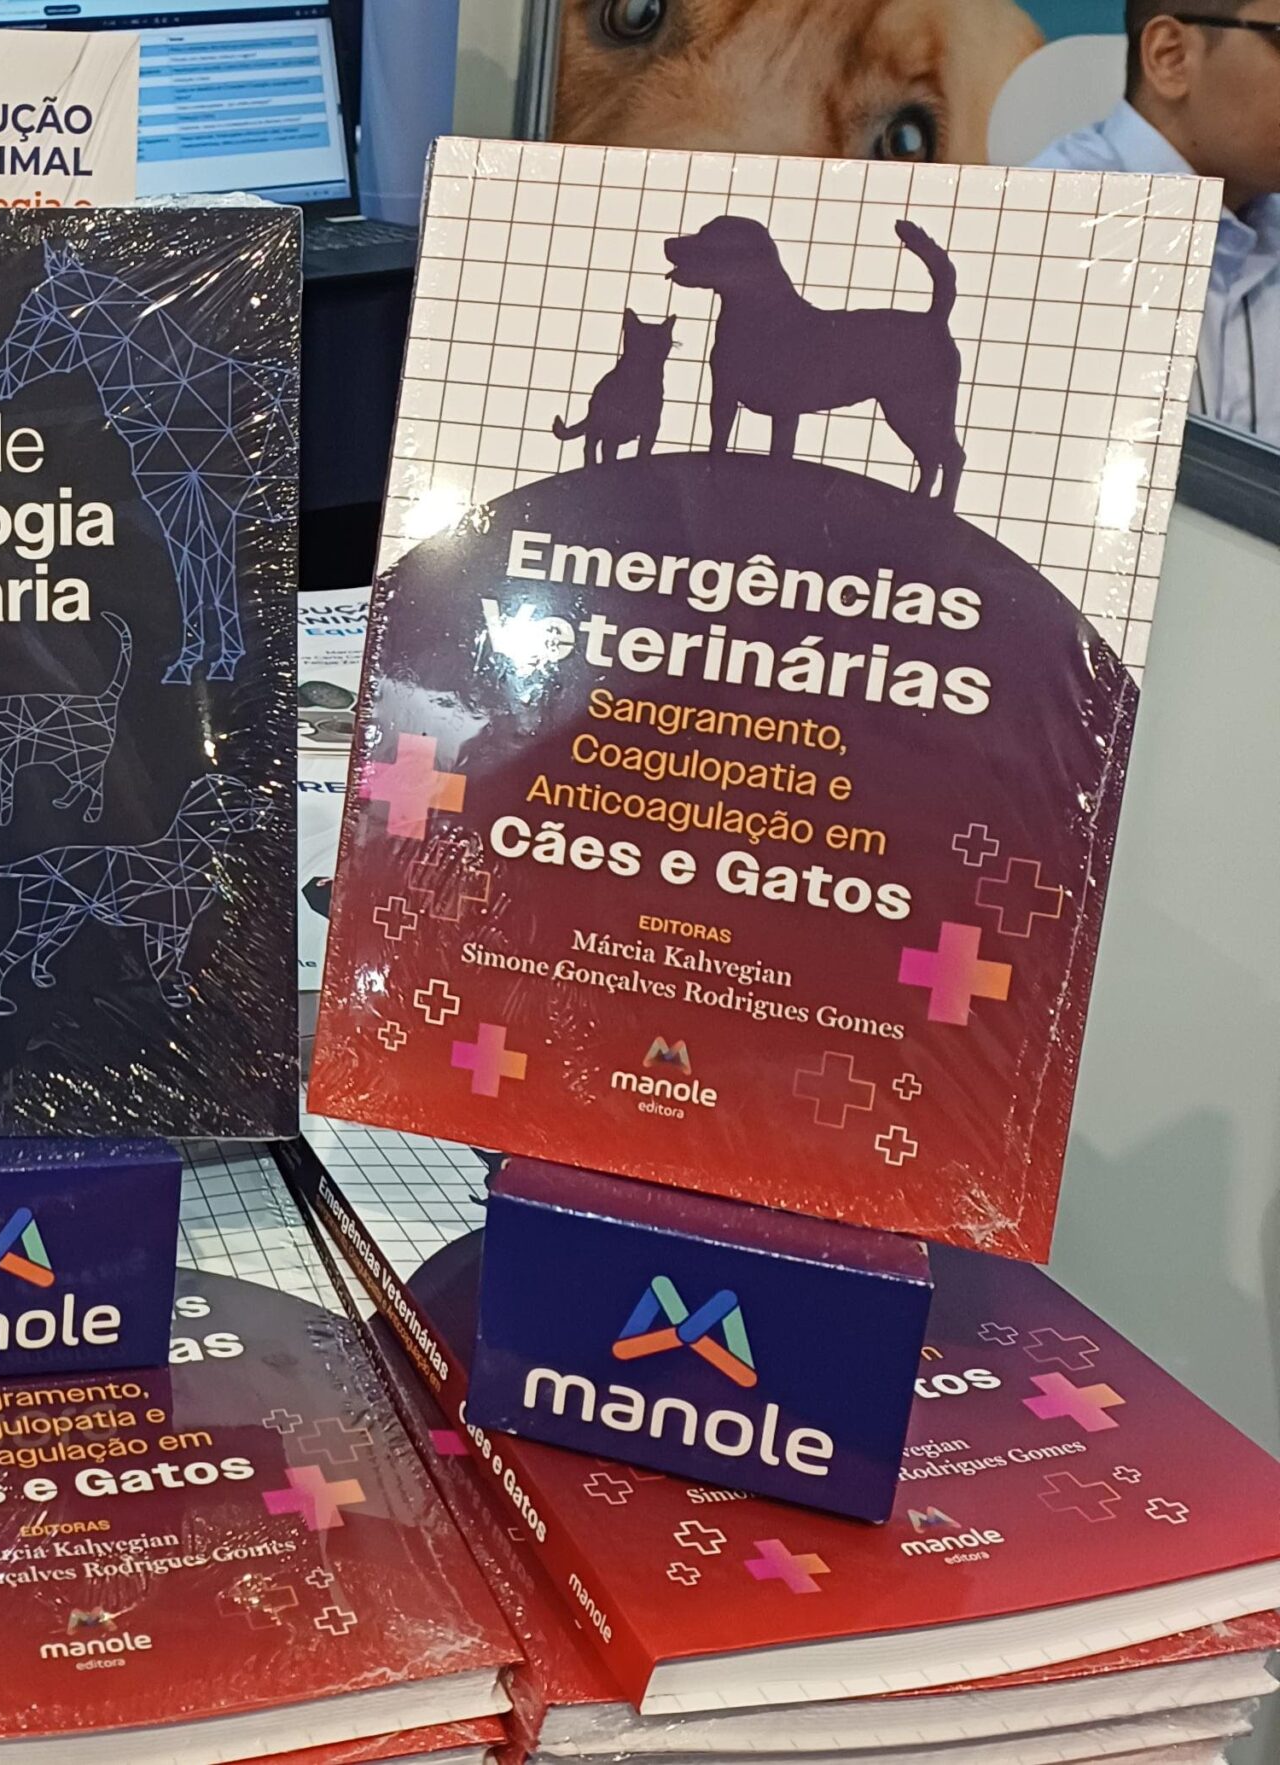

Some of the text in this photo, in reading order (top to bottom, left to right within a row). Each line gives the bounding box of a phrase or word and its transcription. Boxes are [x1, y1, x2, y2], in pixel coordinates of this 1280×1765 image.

[505, 529, 983, 631] Emergências
[588, 687, 849, 755] Sangramento,
[571, 733, 852, 800] Coagulopatia e
[525, 773, 887, 856] Anticoagulação em
[490, 815, 913, 921] Cães e Gatos
[638, 914, 733, 944] EDITORAS
[571, 929, 793, 988] Márcia Kahvegian
[460, 942, 906, 1040] Simone Gonçalves Rodrigues Gomes
[610, 1069, 718, 1108] manole
[638, 1099, 685, 1120] editora
[319, 1175, 381, 1279] Emergências
[381, 1267, 449, 1381] Veterinárias
[146, 1407, 166, 1424] e
[523, 1368, 834, 1476] manole
[159, 1430, 213, 1452] em
[24, 1477, 58, 1503] e
[75, 1457, 256, 1498] Gatos
[686, 1440, 1087, 1504] Simo Rodrigues Gomes
[20, 1519, 111, 1539] EDITORAS
[503, 1469, 548, 1543] Gatos
[53, 1532, 180, 1561] Kahvegian
[900, 1527, 1005, 1557] manole
[943, 1551, 991, 1565] editora
[84, 1551, 209, 1582] Rodrigues
[569, 1572, 613, 1644] manole
[40, 1631, 153, 1659] manole
[75, 1657, 126, 1671] editora
